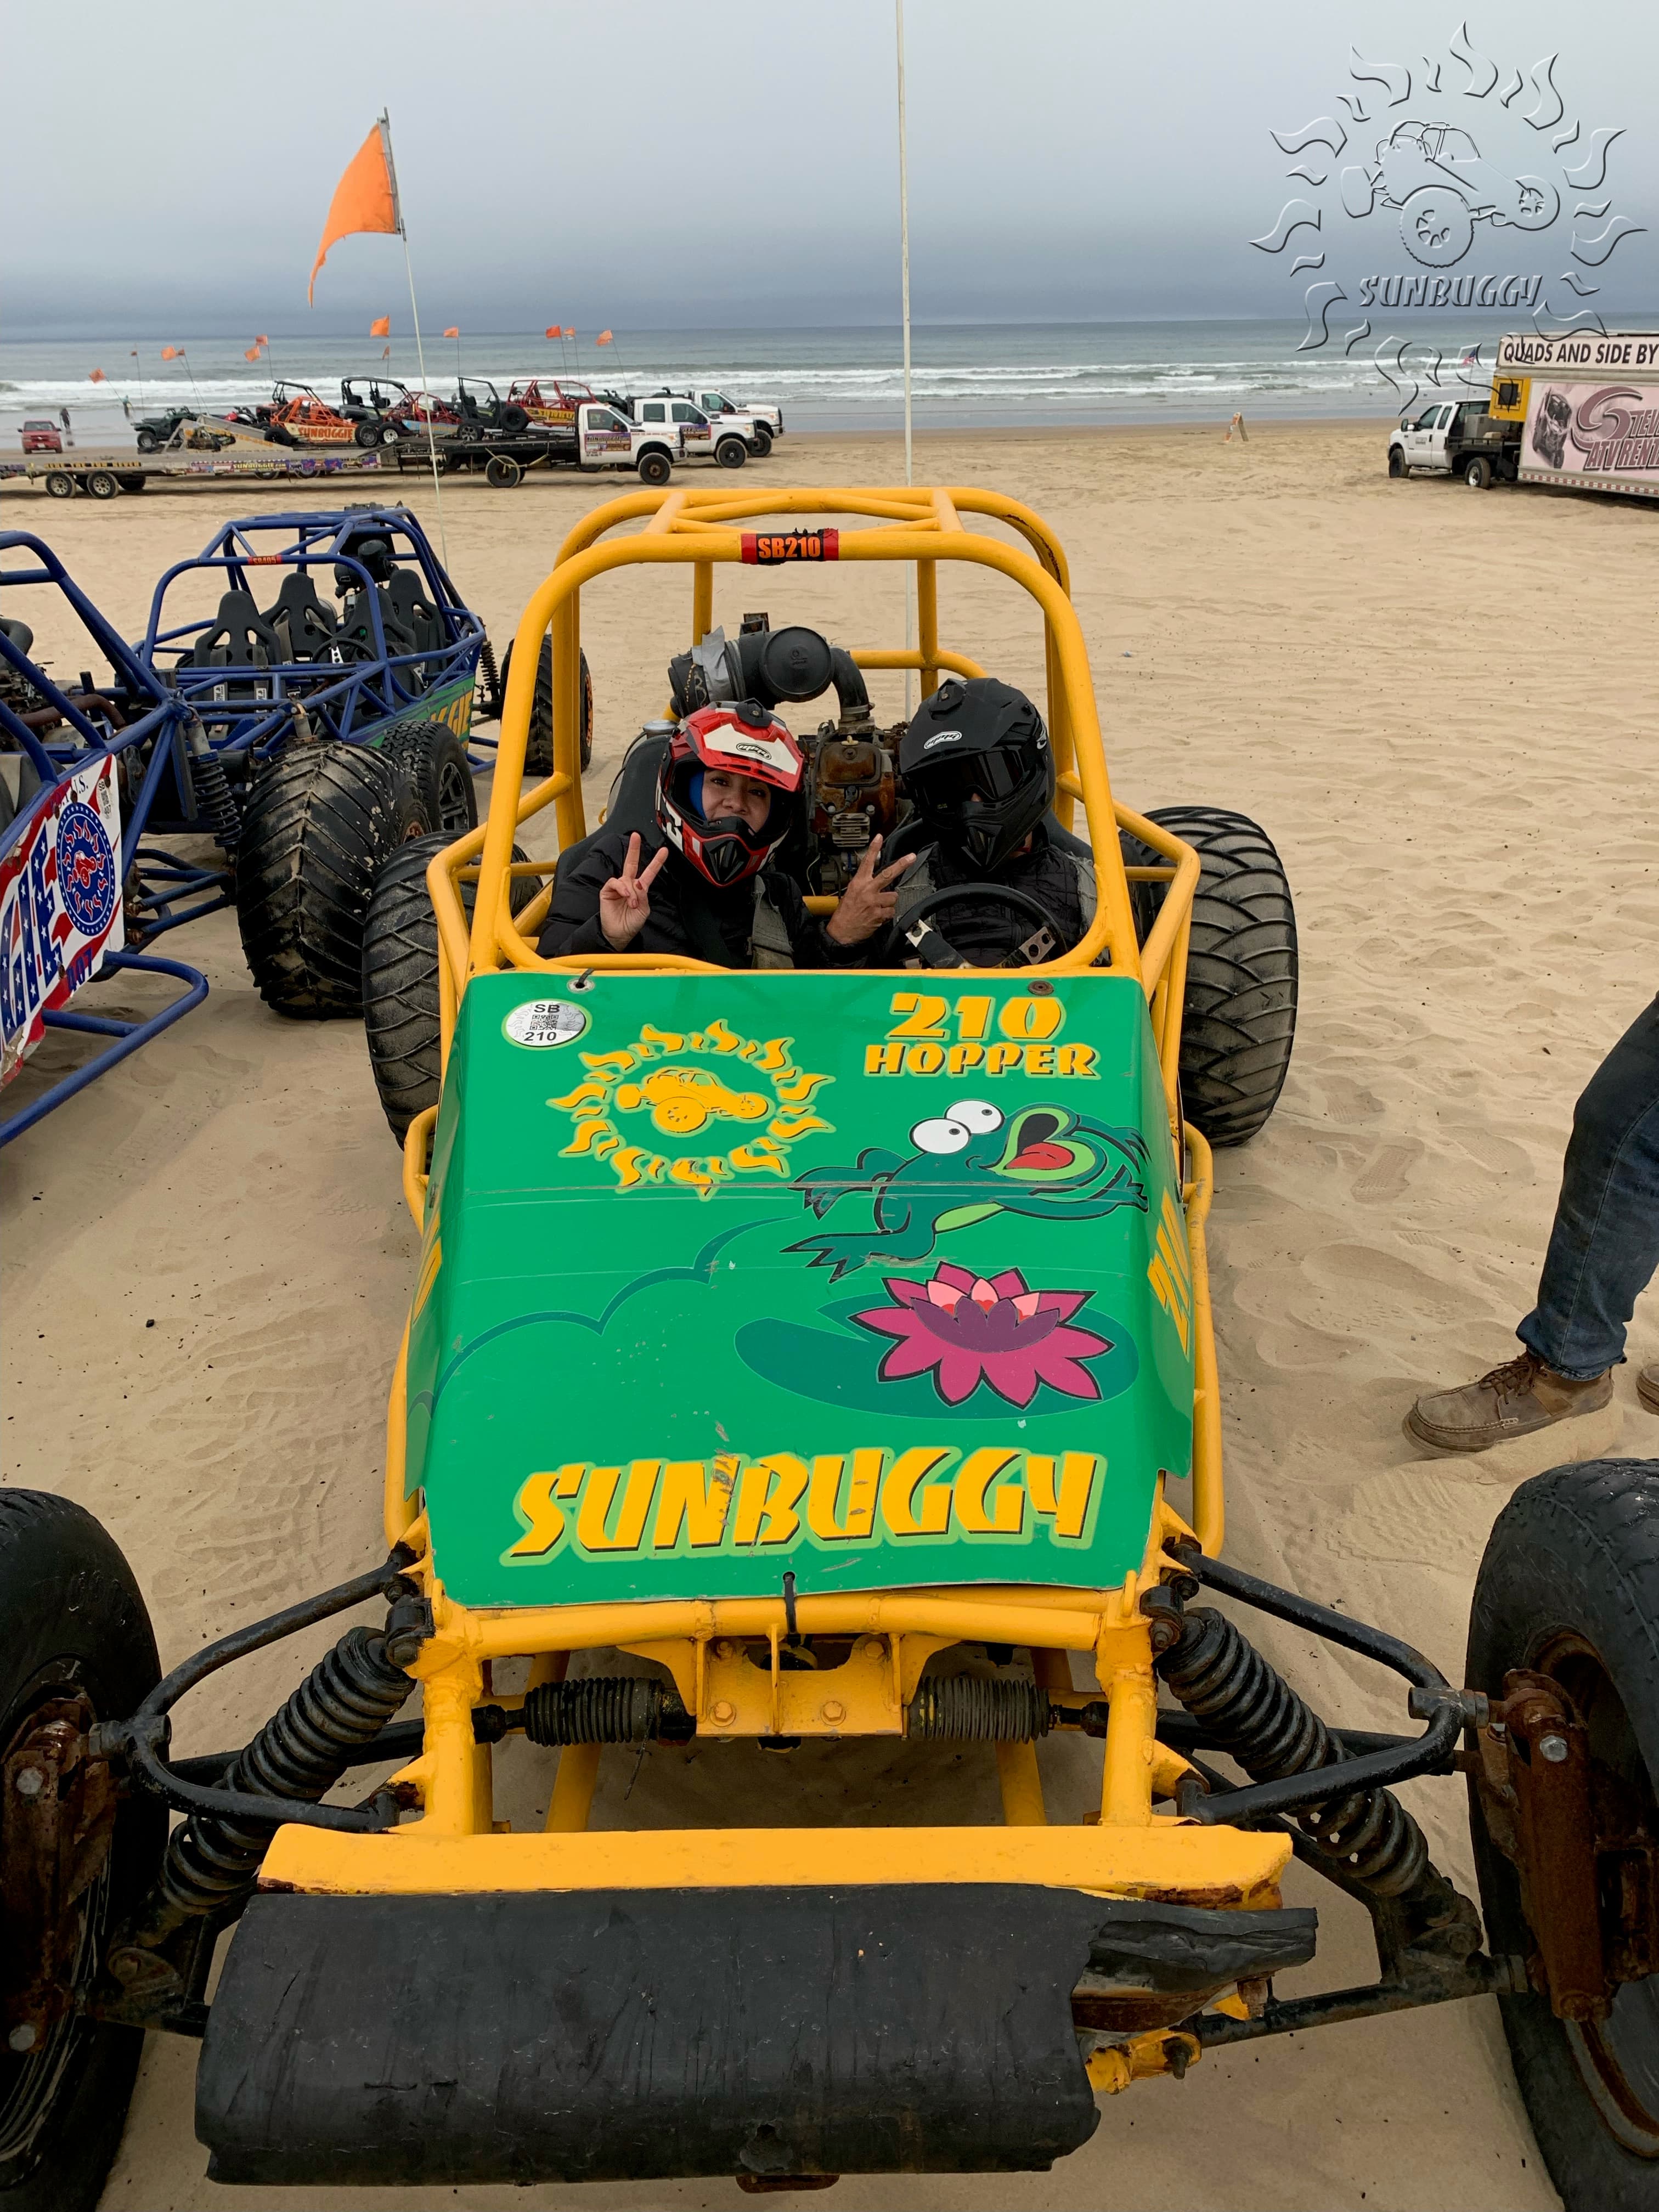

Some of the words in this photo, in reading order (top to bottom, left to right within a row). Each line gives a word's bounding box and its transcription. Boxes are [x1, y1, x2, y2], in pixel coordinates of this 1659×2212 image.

[1504, 343, 1554, 363] QUADS
[1556, 343, 1591, 363] AND
[1595, 343, 1632, 364] SIDE
[1636, 344, 1659, 364] BY
[298, 427, 353, 439] SUNBUGGIE
[1571, 386, 1659, 458] STEV
[1583, 439, 1621, 471] ATV
[1615, 438, 1659, 469] RENT
[758, 537, 821, 558] SB210
[534, 1005, 560, 1013] SB
[889, 993, 1062, 1039] 210
[524, 1031, 557, 1041] 210
[865, 1043, 1097, 1076] HOPPER
[509, 1448, 1099, 1557] SUNBUGGY
